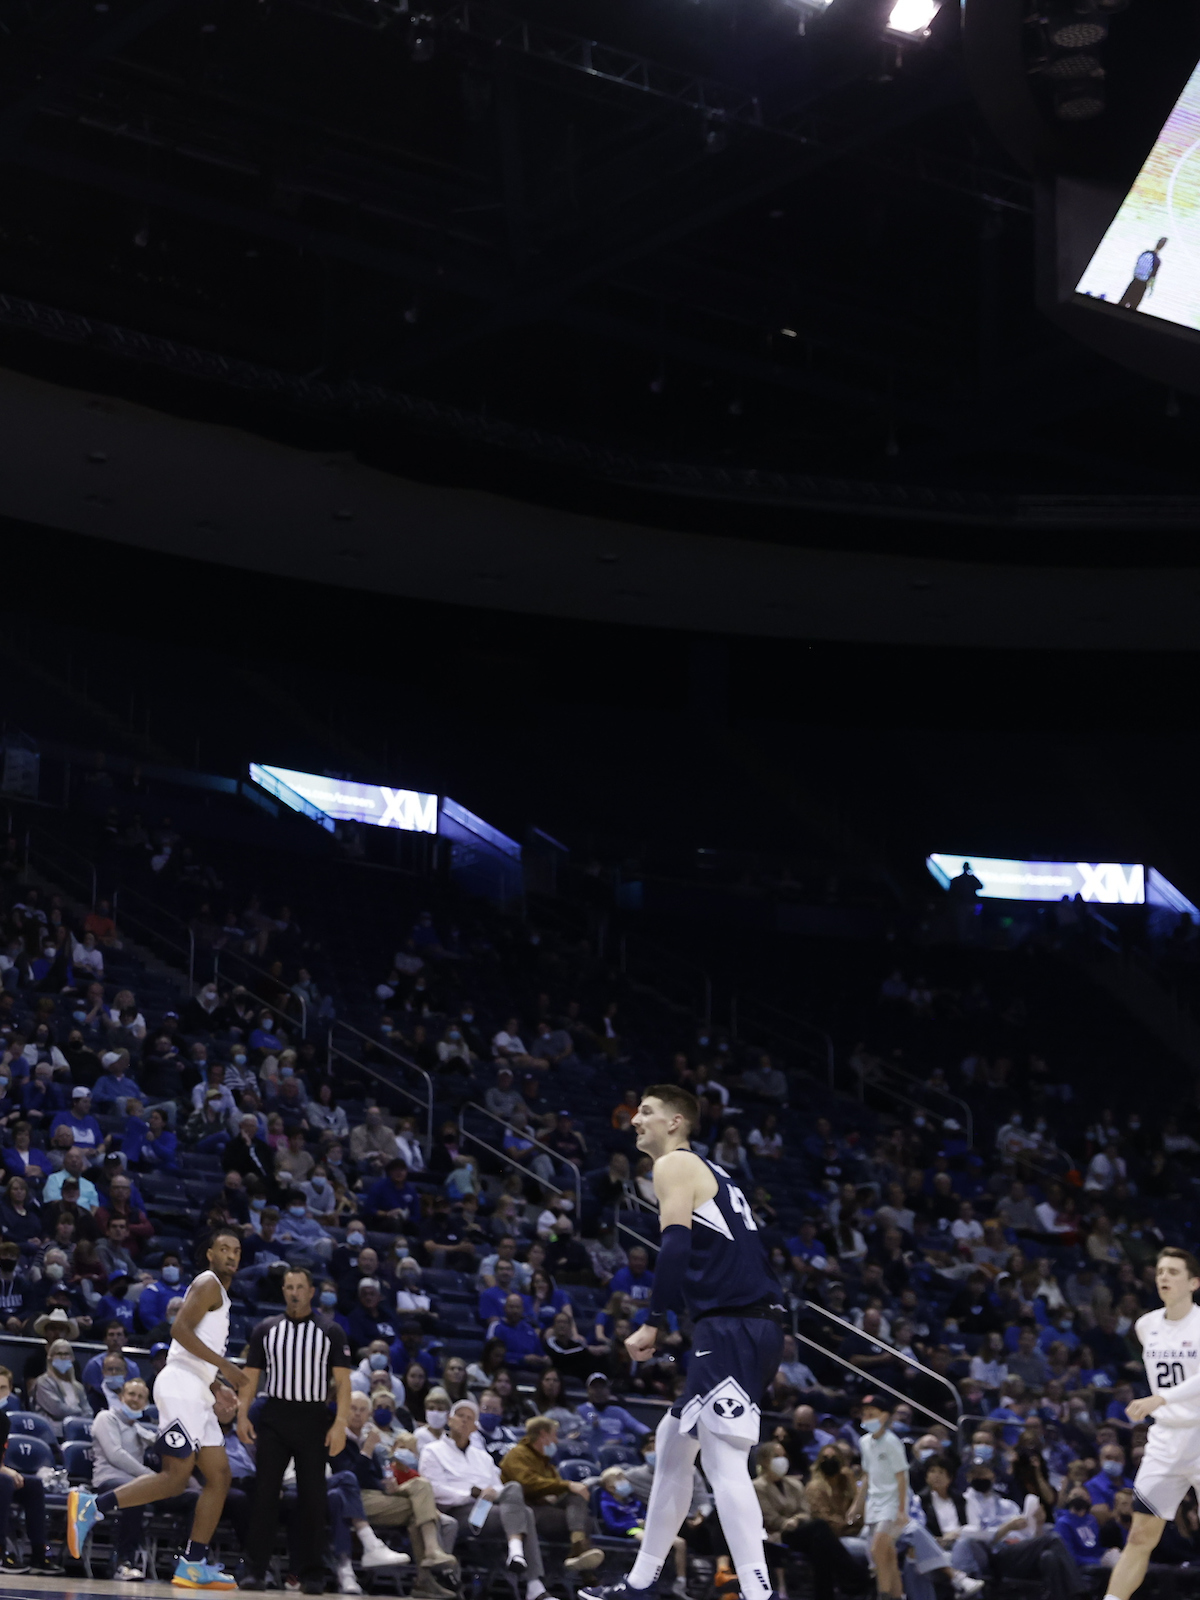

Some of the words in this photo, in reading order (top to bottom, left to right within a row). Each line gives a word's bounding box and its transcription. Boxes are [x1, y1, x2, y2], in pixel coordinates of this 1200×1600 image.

[377, 786, 437, 835] XM
[1075, 862, 1145, 904] XM
[1156, 1362, 1185, 1388] 20
[19, 1443, 32, 1456] 17
